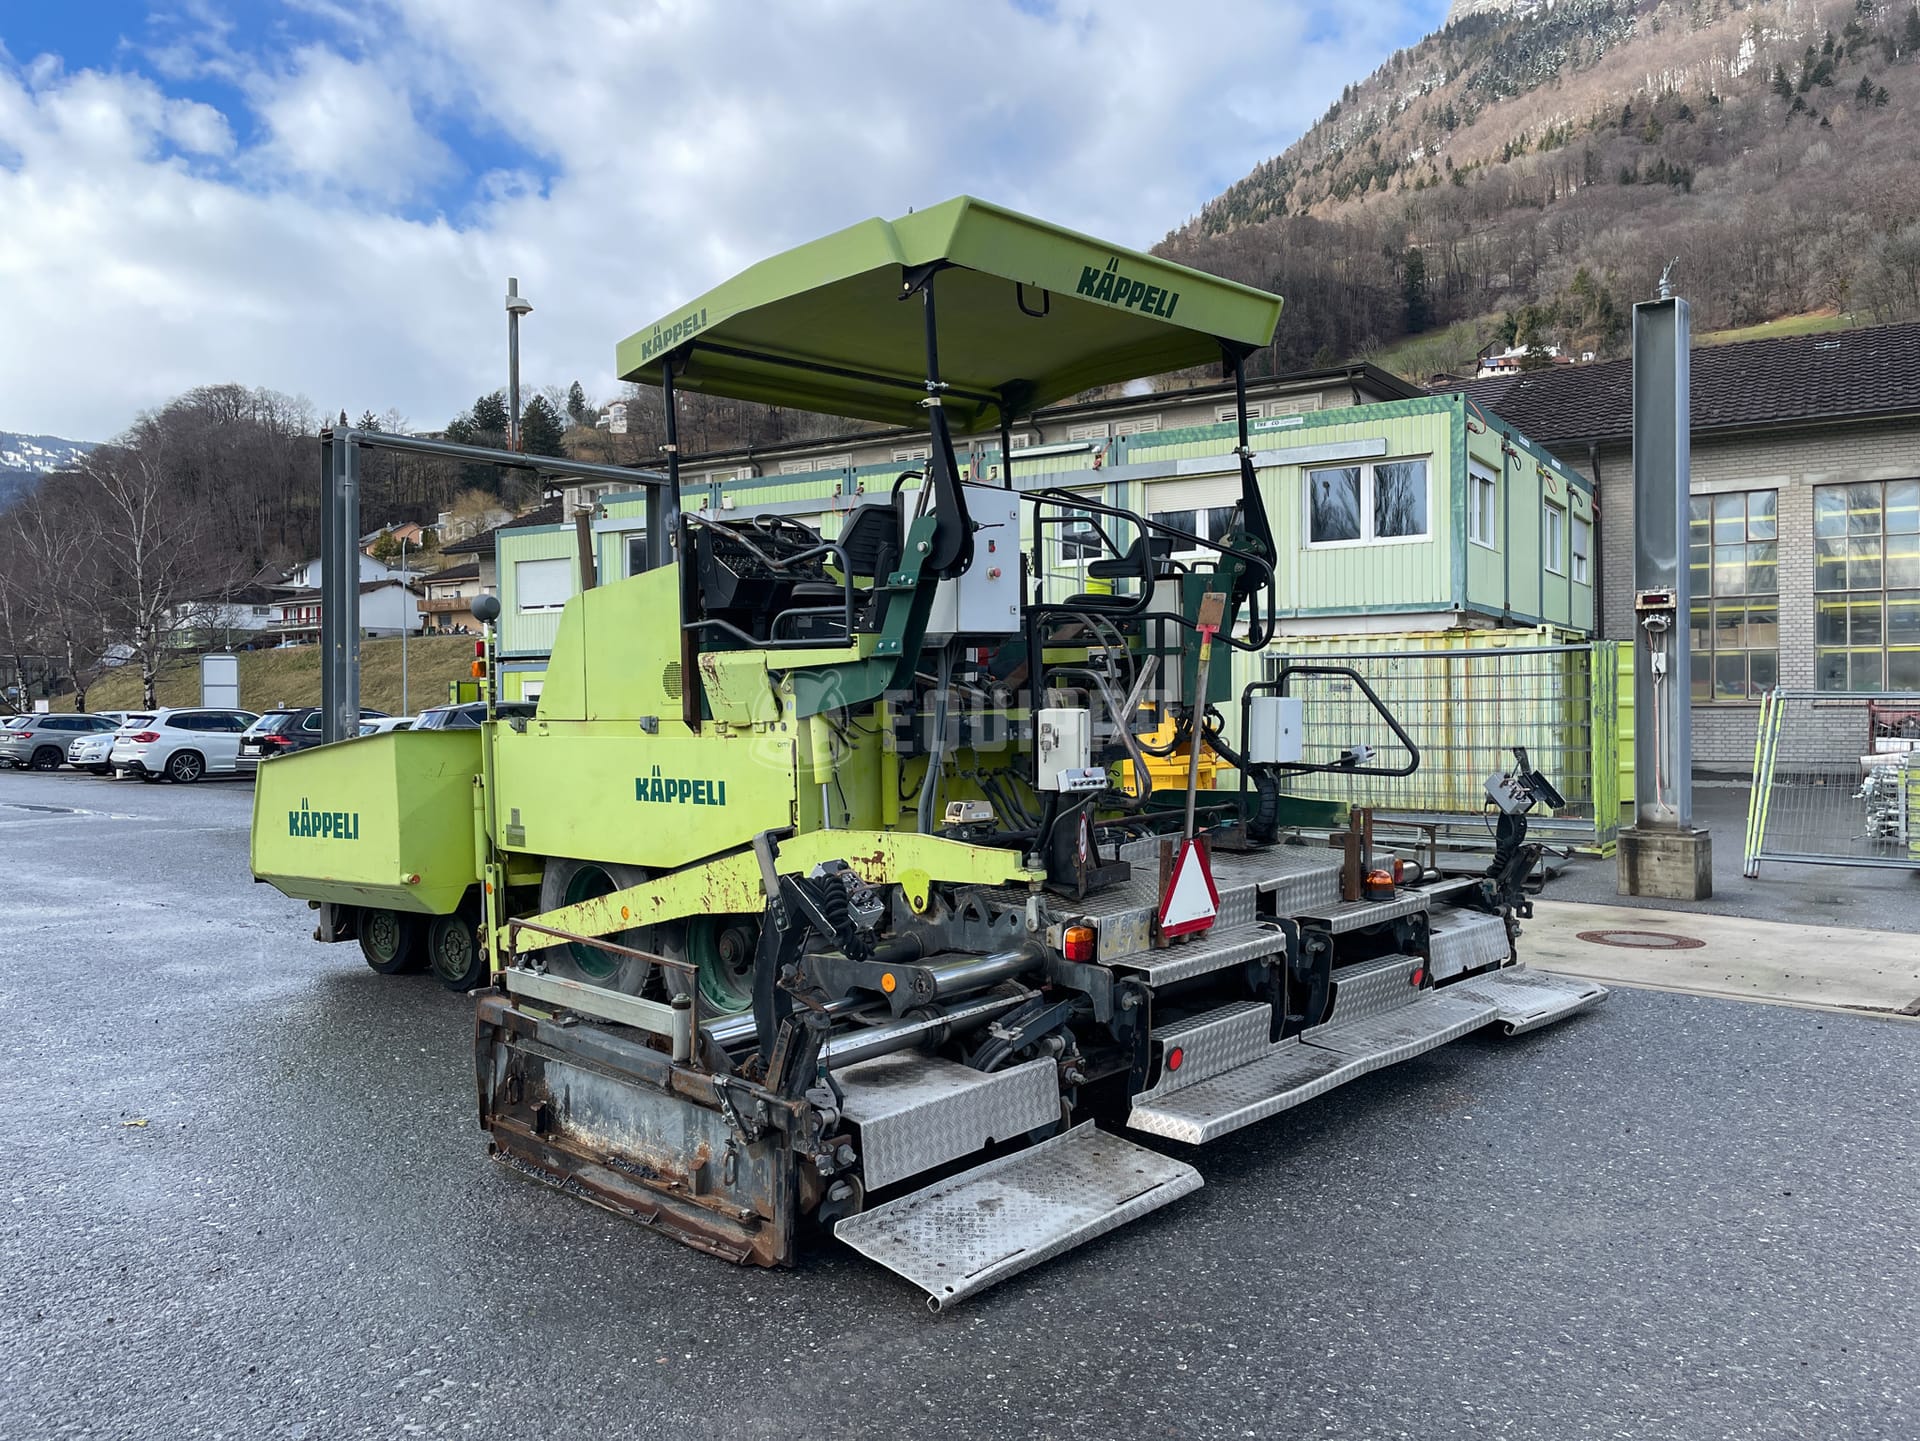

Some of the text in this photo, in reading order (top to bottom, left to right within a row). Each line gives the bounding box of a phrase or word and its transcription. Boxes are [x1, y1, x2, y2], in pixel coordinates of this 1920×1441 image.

[1076, 256, 1180, 319] KÄPPELI
[641, 307, 708, 361] KÄPPELI
[635, 764, 726, 806] KÄPPELI
[288, 796, 359, 841] KÄPPELI
